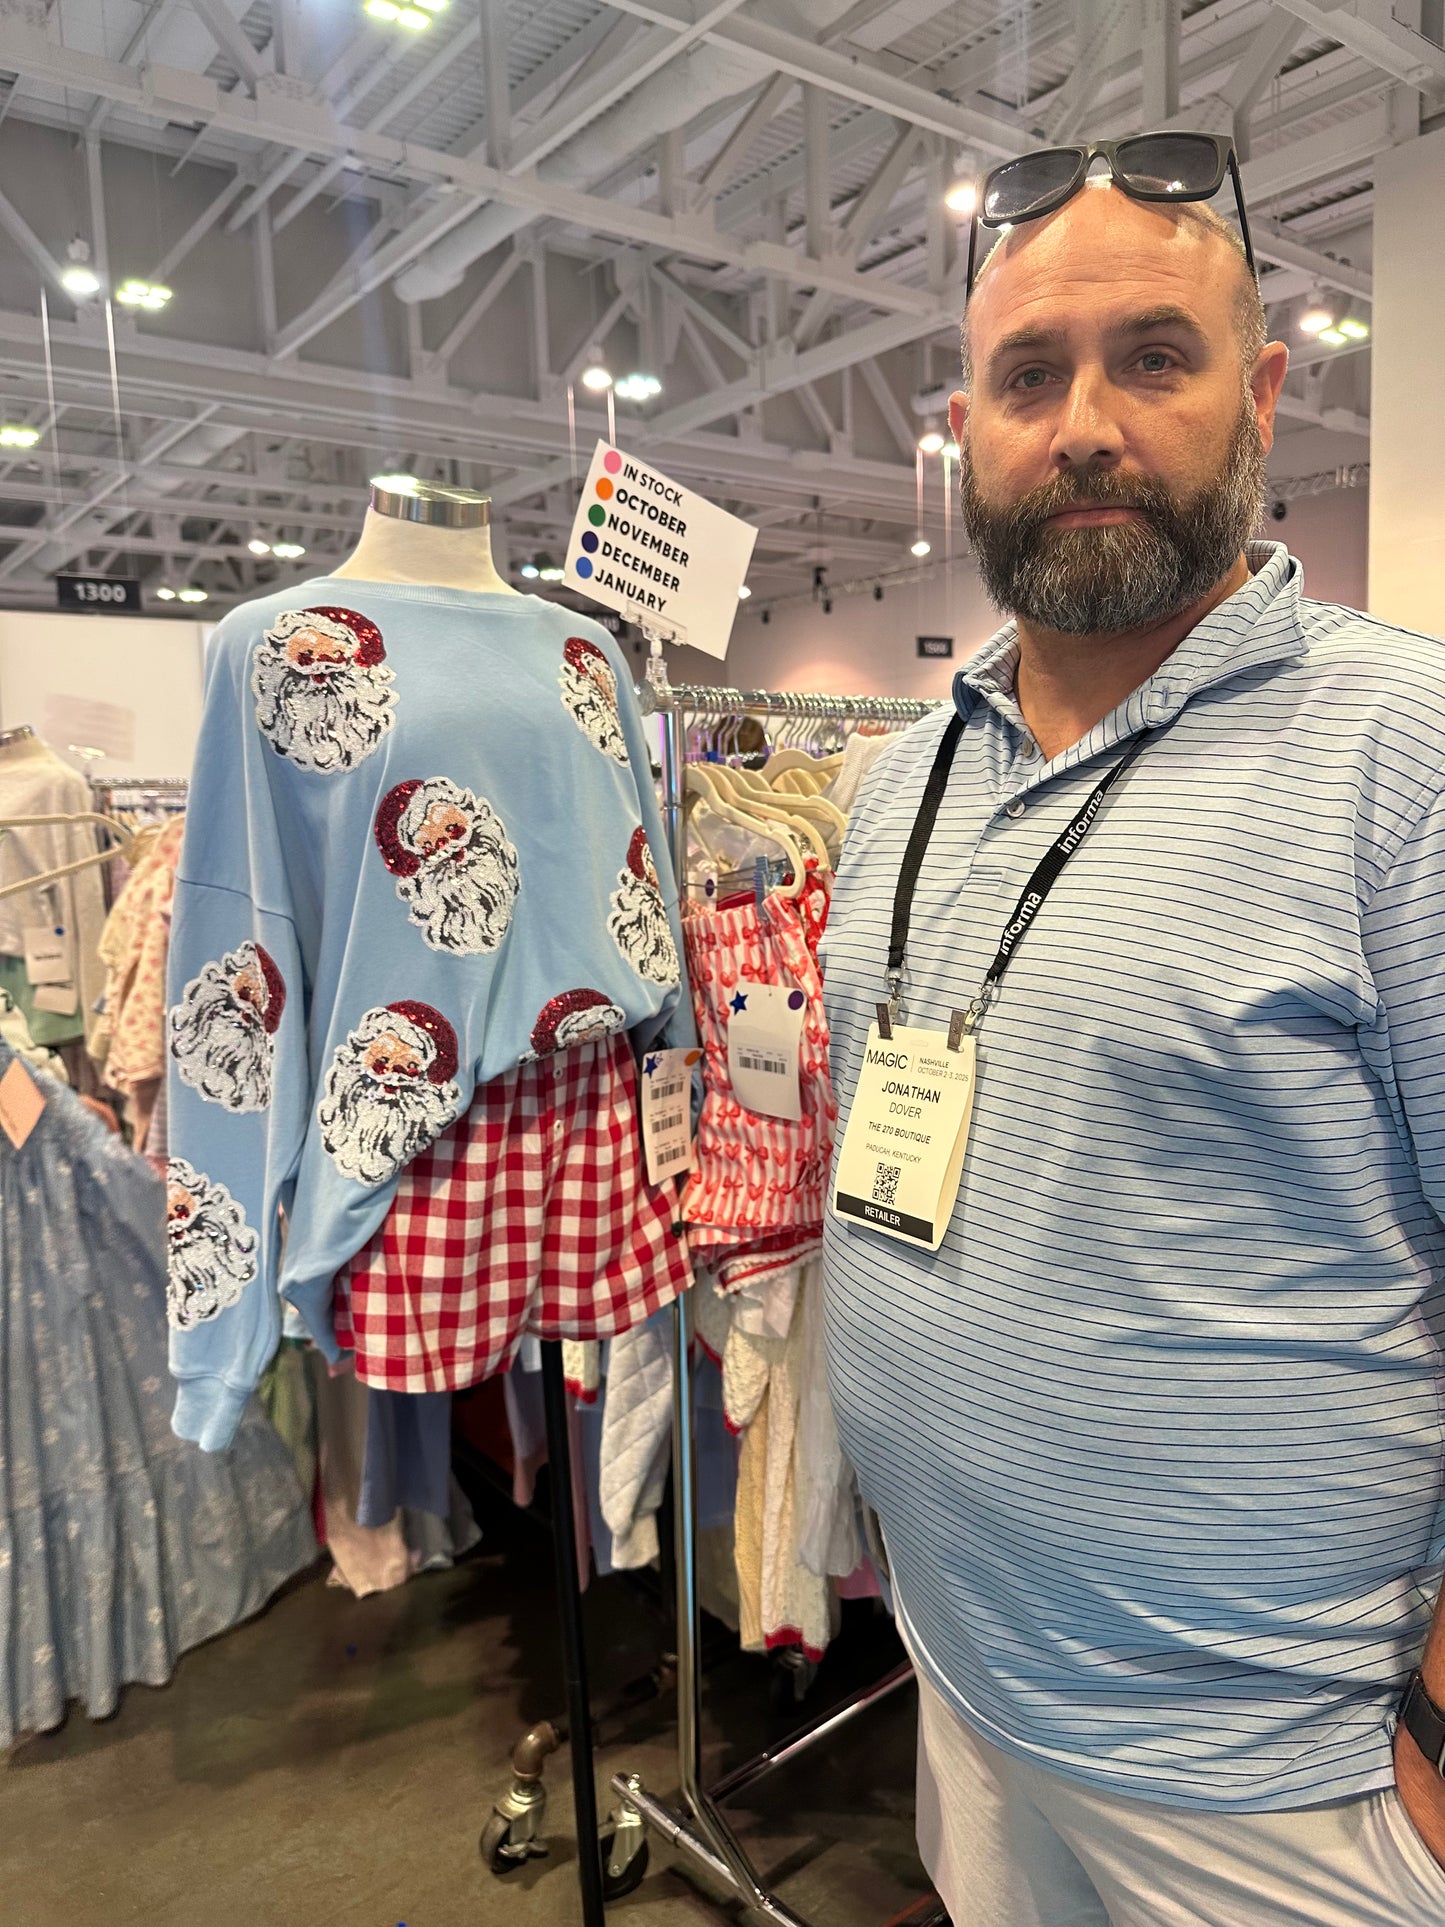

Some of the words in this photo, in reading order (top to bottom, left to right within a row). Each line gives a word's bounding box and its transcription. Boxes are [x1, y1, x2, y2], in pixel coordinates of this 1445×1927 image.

[623, 464, 639, 482] IN
[640, 473, 684, 507] STOCK
[616, 488, 687, 537] OCTOBER
[608, 514, 689, 567] NOVEMBER
[601, 541, 680, 592] DECEMBER
[74, 582, 127, 603] 1300
[595, 569, 667, 612] JANUARY
[1057, 789, 1104, 854] informa
[999, 891, 1042, 956] informa
[866, 1049, 908, 1070] MAGIC
[919, 1057, 950, 1069] NASHVILLE
[917, 1066, 943, 1077] OCTOBER
[881, 1080, 941, 1104] JONATHAN
[889, 1101, 922, 1119] DOVER
[868, 1121, 881, 1132] THE
[882, 1124, 894, 1135] 270
[894, 1127, 931, 1144] BOUTIQUE
[892, 1150, 922, 1164] KENTUCKY
[864, 1205, 901, 1226] RETAILER
